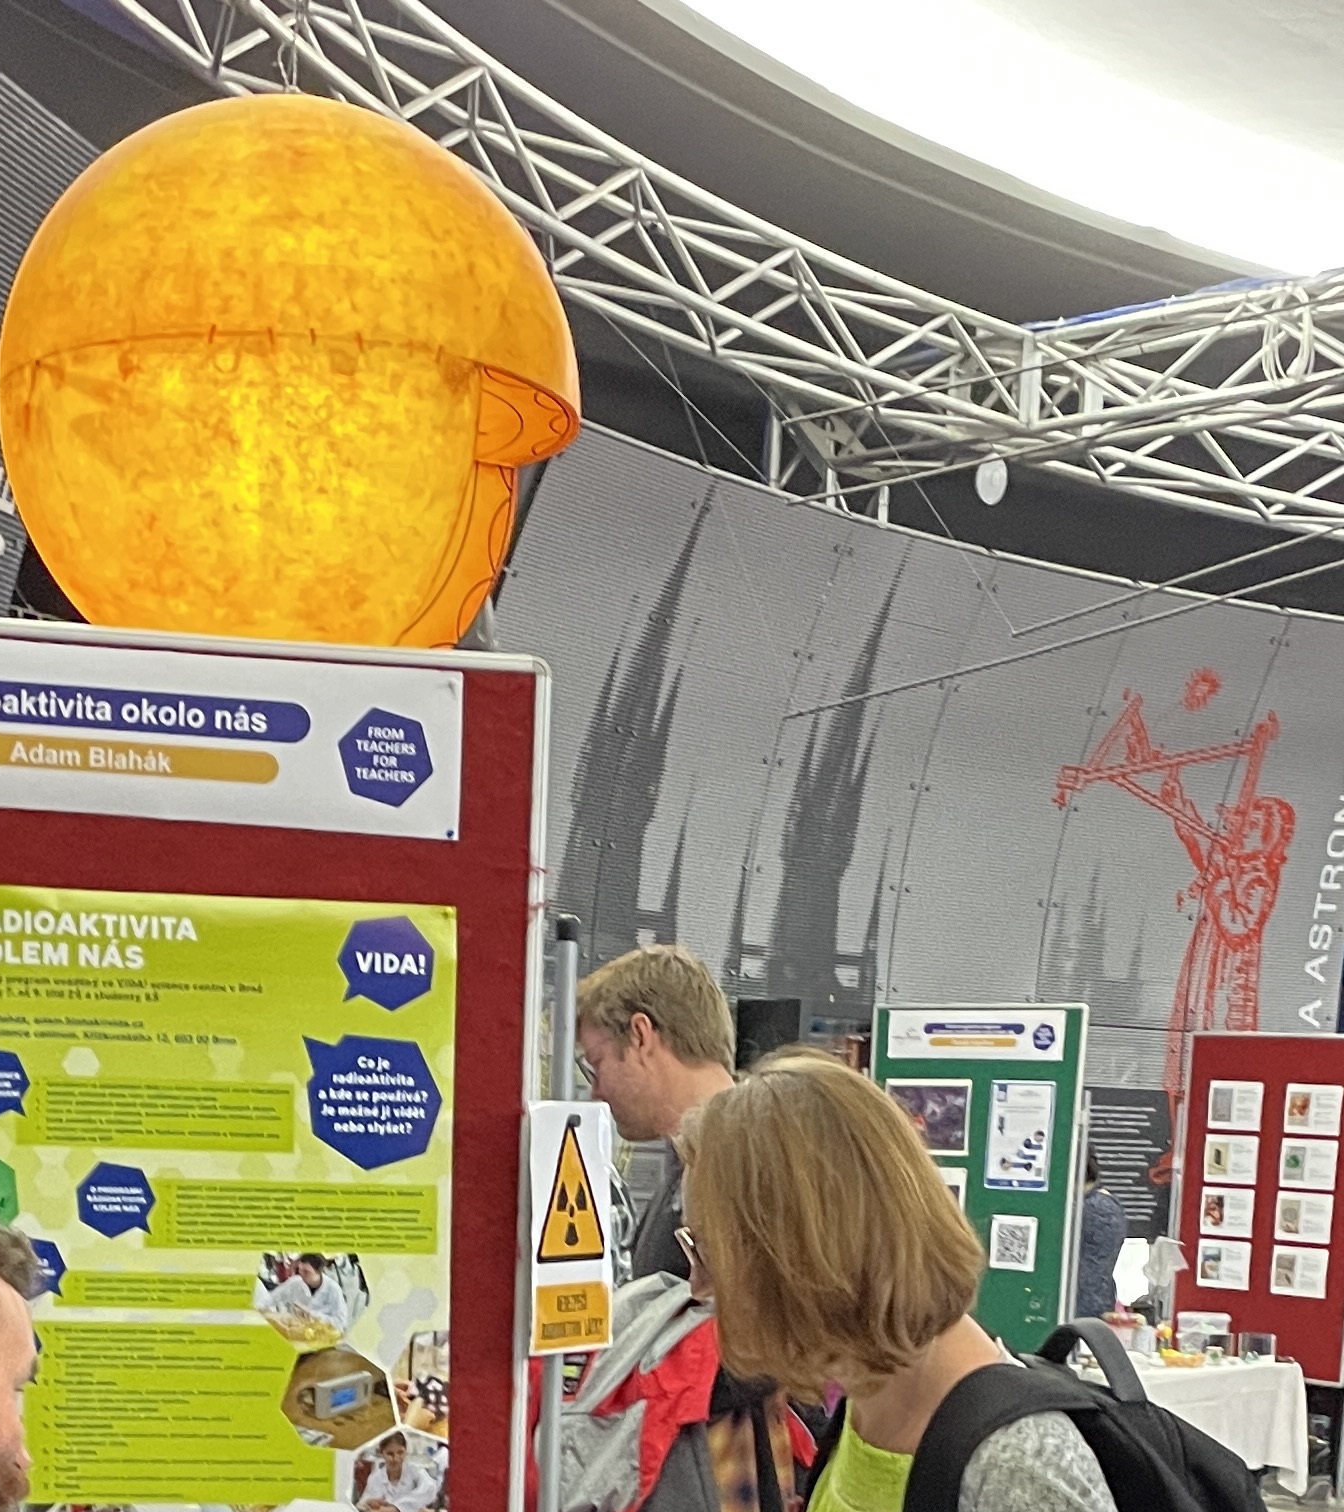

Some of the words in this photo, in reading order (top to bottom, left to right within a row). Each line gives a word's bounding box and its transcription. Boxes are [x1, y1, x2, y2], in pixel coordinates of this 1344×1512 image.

[121, 700, 206, 730] okolo
[214, 704, 268, 733] nás
[367, 725, 405, 740] FROM
[355, 738, 416, 756] TEACHERS
[10, 741, 82, 767] Adam
[88, 747, 173, 773] Blahák
[372, 754, 398, 768] FOR
[354, 766, 416, 784] TEACHERS
[77, 938, 145, 970] NÁS
[355, 950, 427, 975] VIDA!
[1297, 997, 1323, 1029] A
[357, 1055, 376, 1069] Co
[376, 1056, 391, 1072] je
[332, 1071, 415, 1087] radioaktivita
[318, 1089, 327, 1100] a
[329, 1087, 352, 1101] kde
[355, 1090, 370, 1101] se
[372, 1089, 429, 1104] používá?
[320, 1103, 336, 1117] Je
[338, 1103, 380, 1118] možné
[333, 1120, 366, 1133] nebo
[367, 1120, 413, 1136] slyšet?
